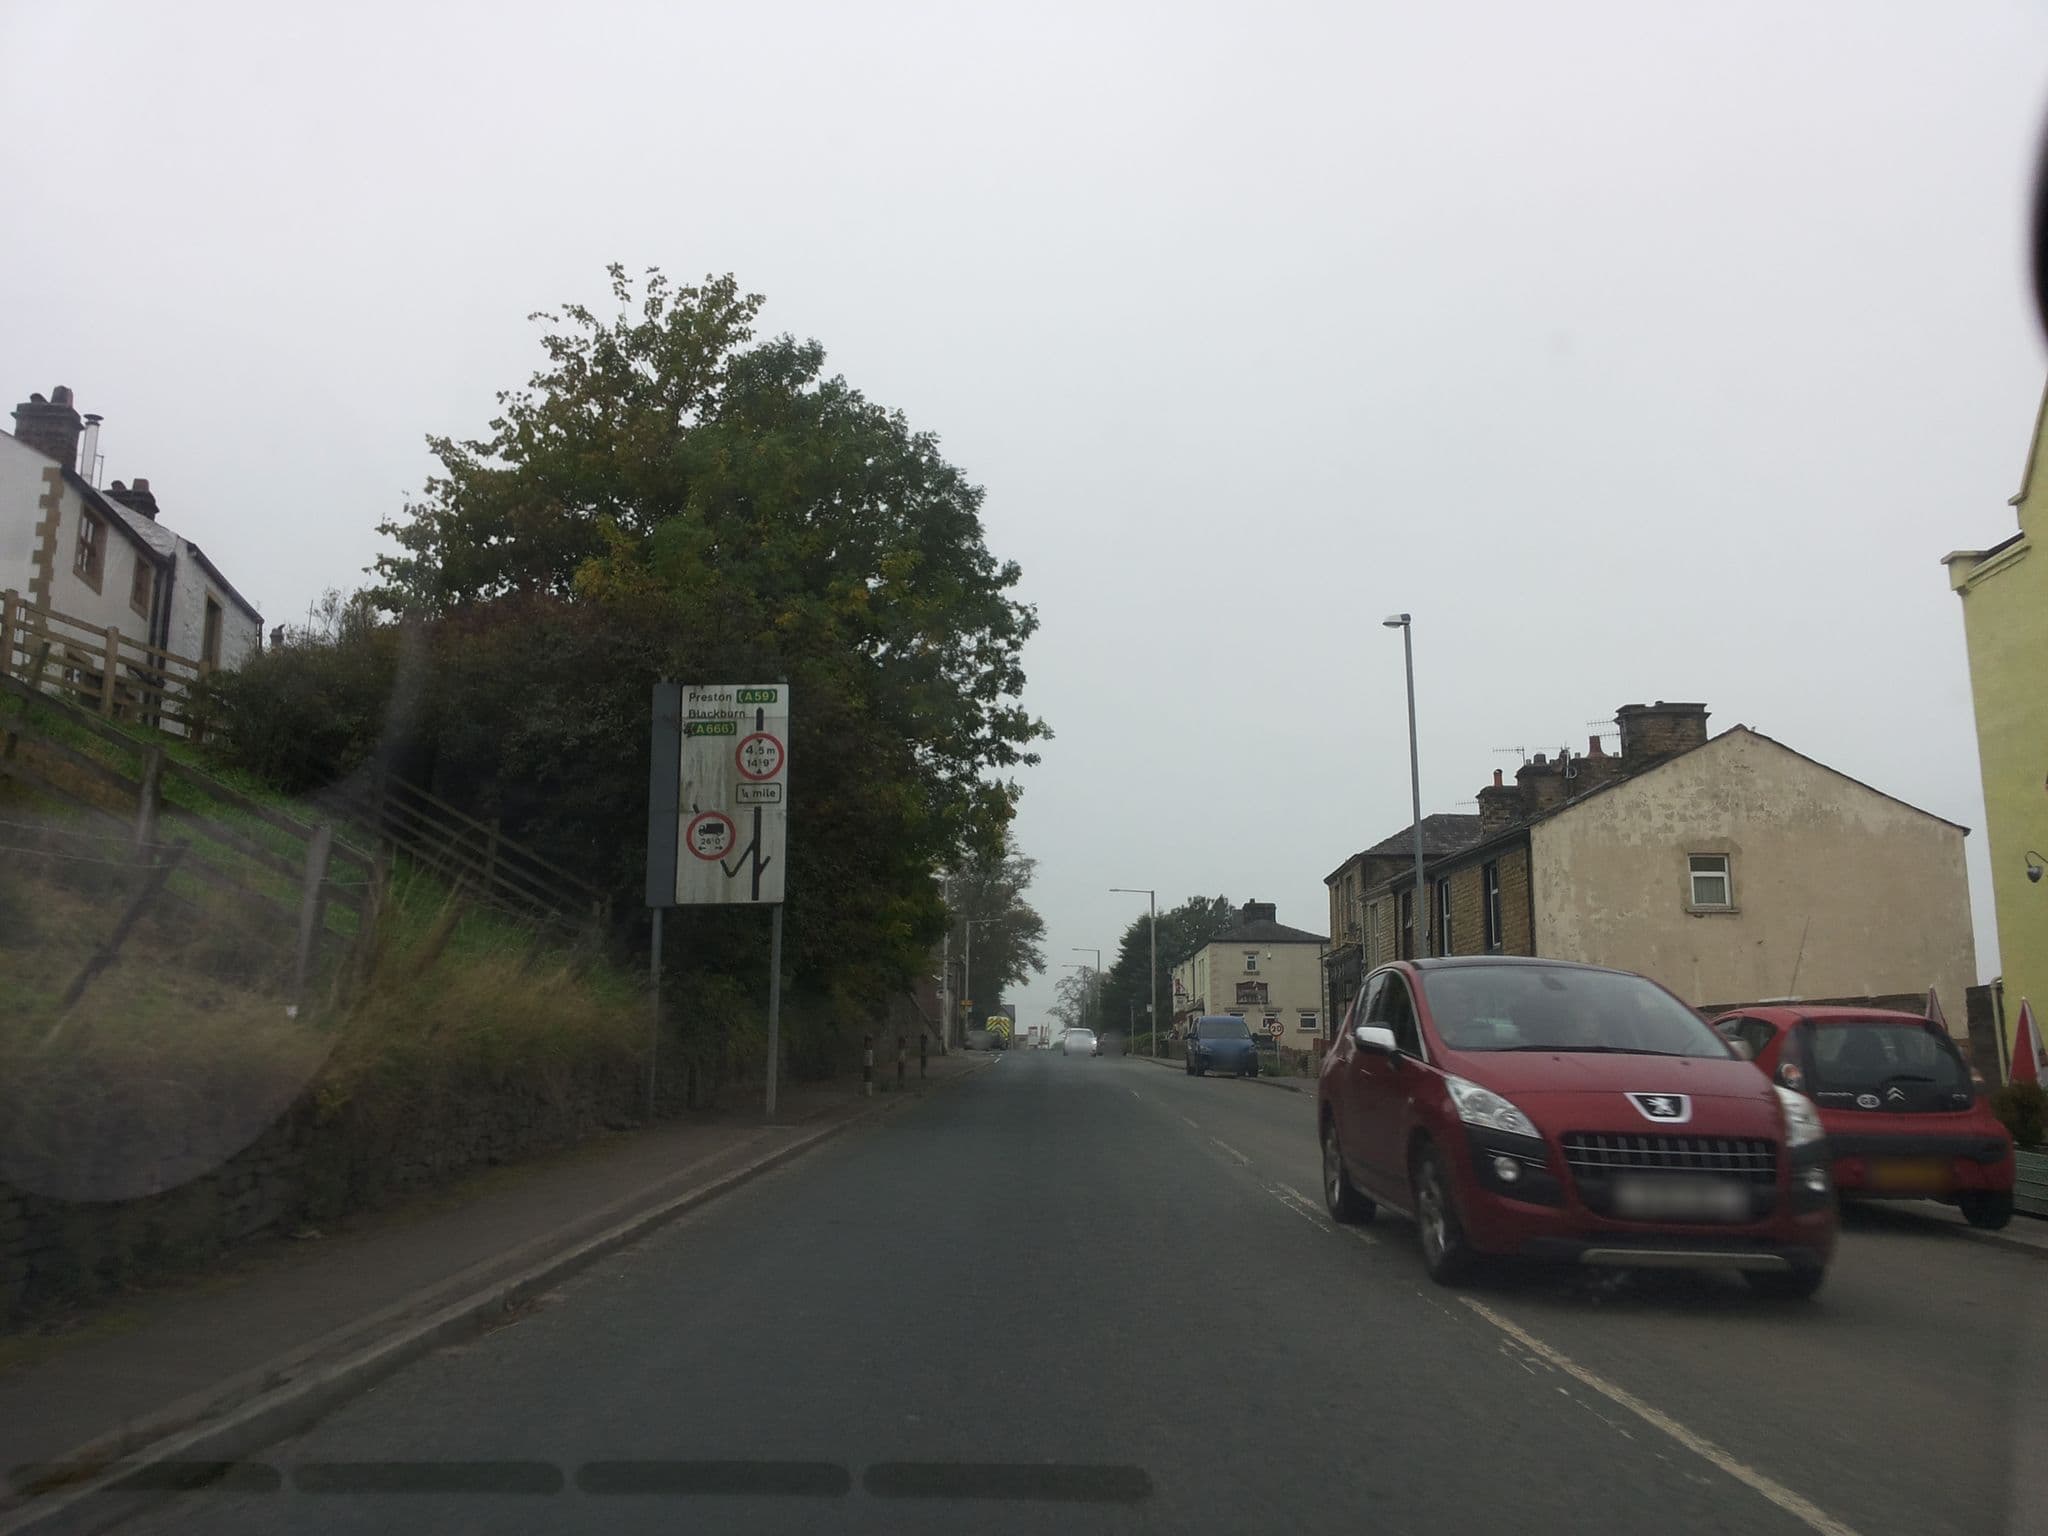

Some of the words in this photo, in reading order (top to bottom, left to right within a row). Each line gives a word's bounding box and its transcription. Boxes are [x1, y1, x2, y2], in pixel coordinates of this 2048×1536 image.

[689, 692, 732, 702] Preston
[738, 690, 776, 702] (A59)
[689, 708, 745, 719] Blackburn
[753, 788, 776, 798] mile
[1271, 1025, 1281, 1033] 20
